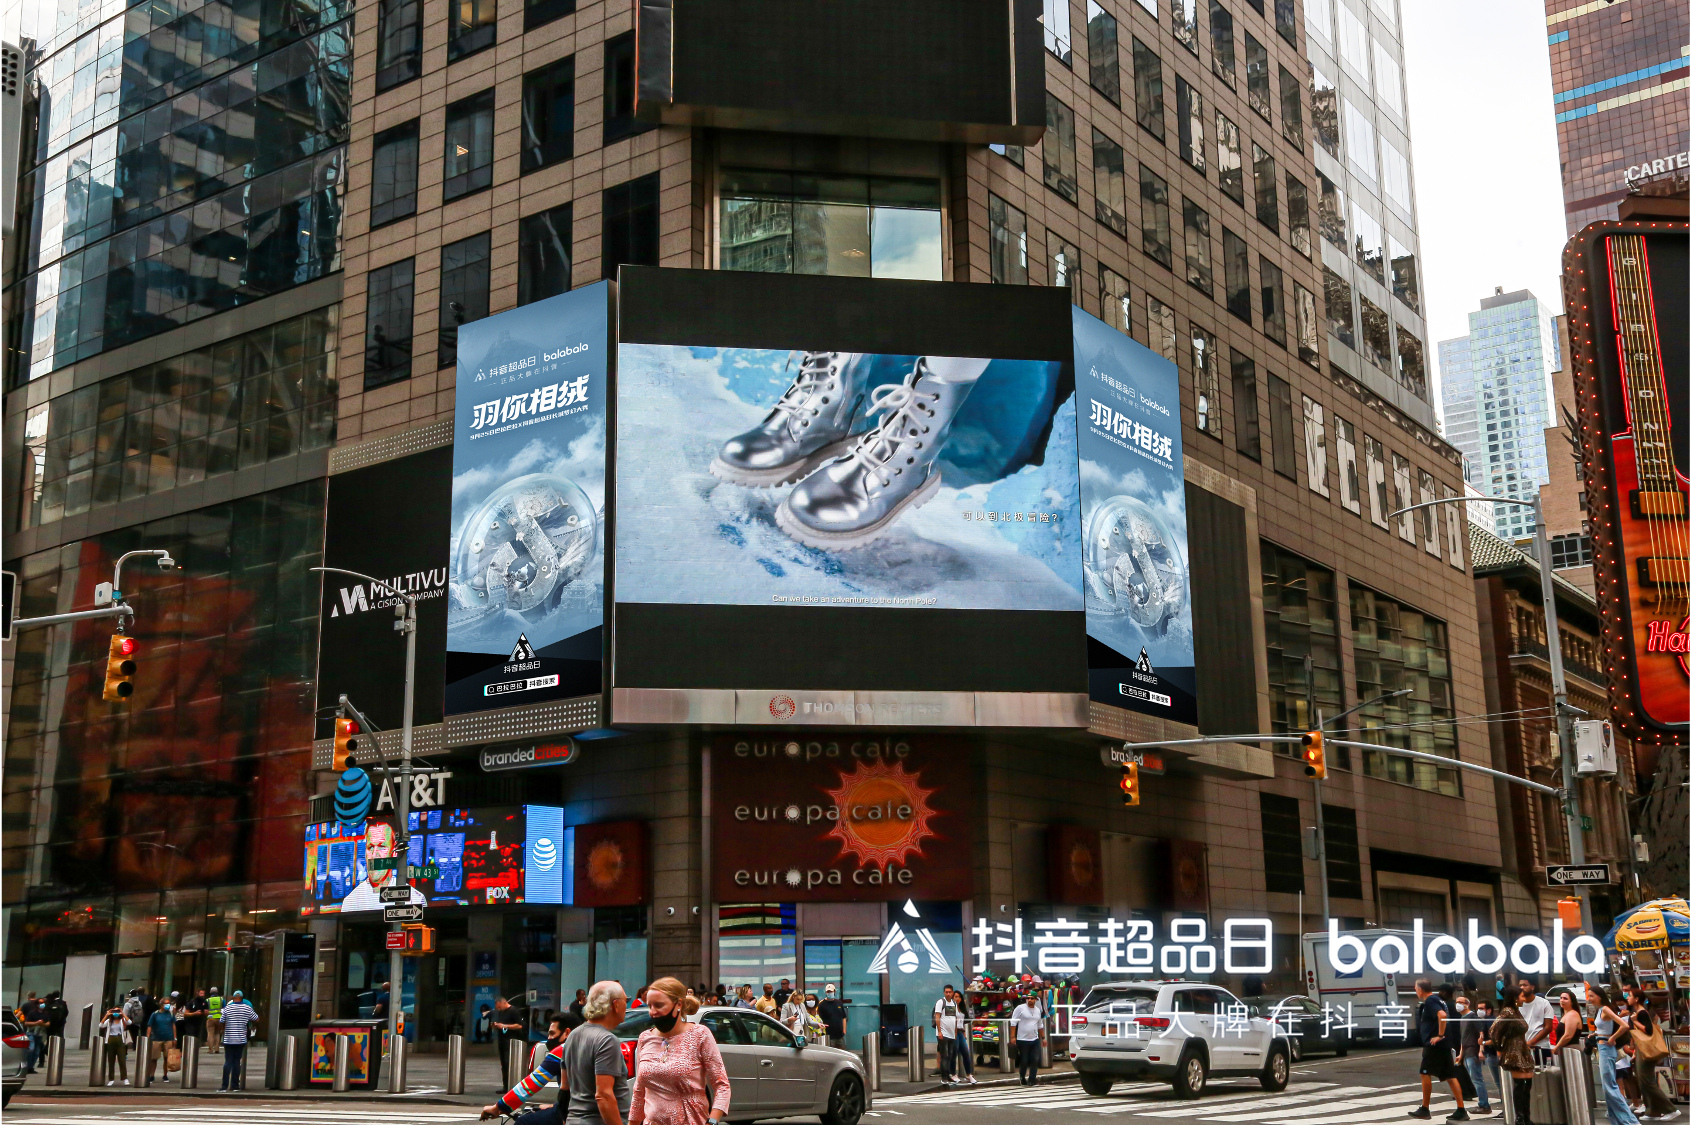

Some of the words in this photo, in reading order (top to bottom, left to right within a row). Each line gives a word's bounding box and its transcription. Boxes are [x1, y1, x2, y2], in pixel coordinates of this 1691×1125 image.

[1627, 151, 1690, 181] CARTE
[543, 342, 589, 362] balabala
[489, 355, 536, 378] 抖音超品日
[469, 374, 590, 430] 羽你相绒
[1140, 393, 1170, 417] balabala
[1089, 398, 1174, 462] 羽你相绒
[370, 567, 447, 600] MULTIVU
[370, 602, 376, 610] A
[377, 597, 403, 609] CISION
[772, 594, 788, 602] Can
[802, 595, 819, 603] take
[1647, 620, 1690, 653] Ha
[734, 804, 841, 825] europa
[415, 867, 421, 877] W
[424, 869, 431, 878] 43
[734, 866, 843, 891] europa
[486, 886, 509, 899] FOX
[1619, 938, 1665, 949] SABRETT
